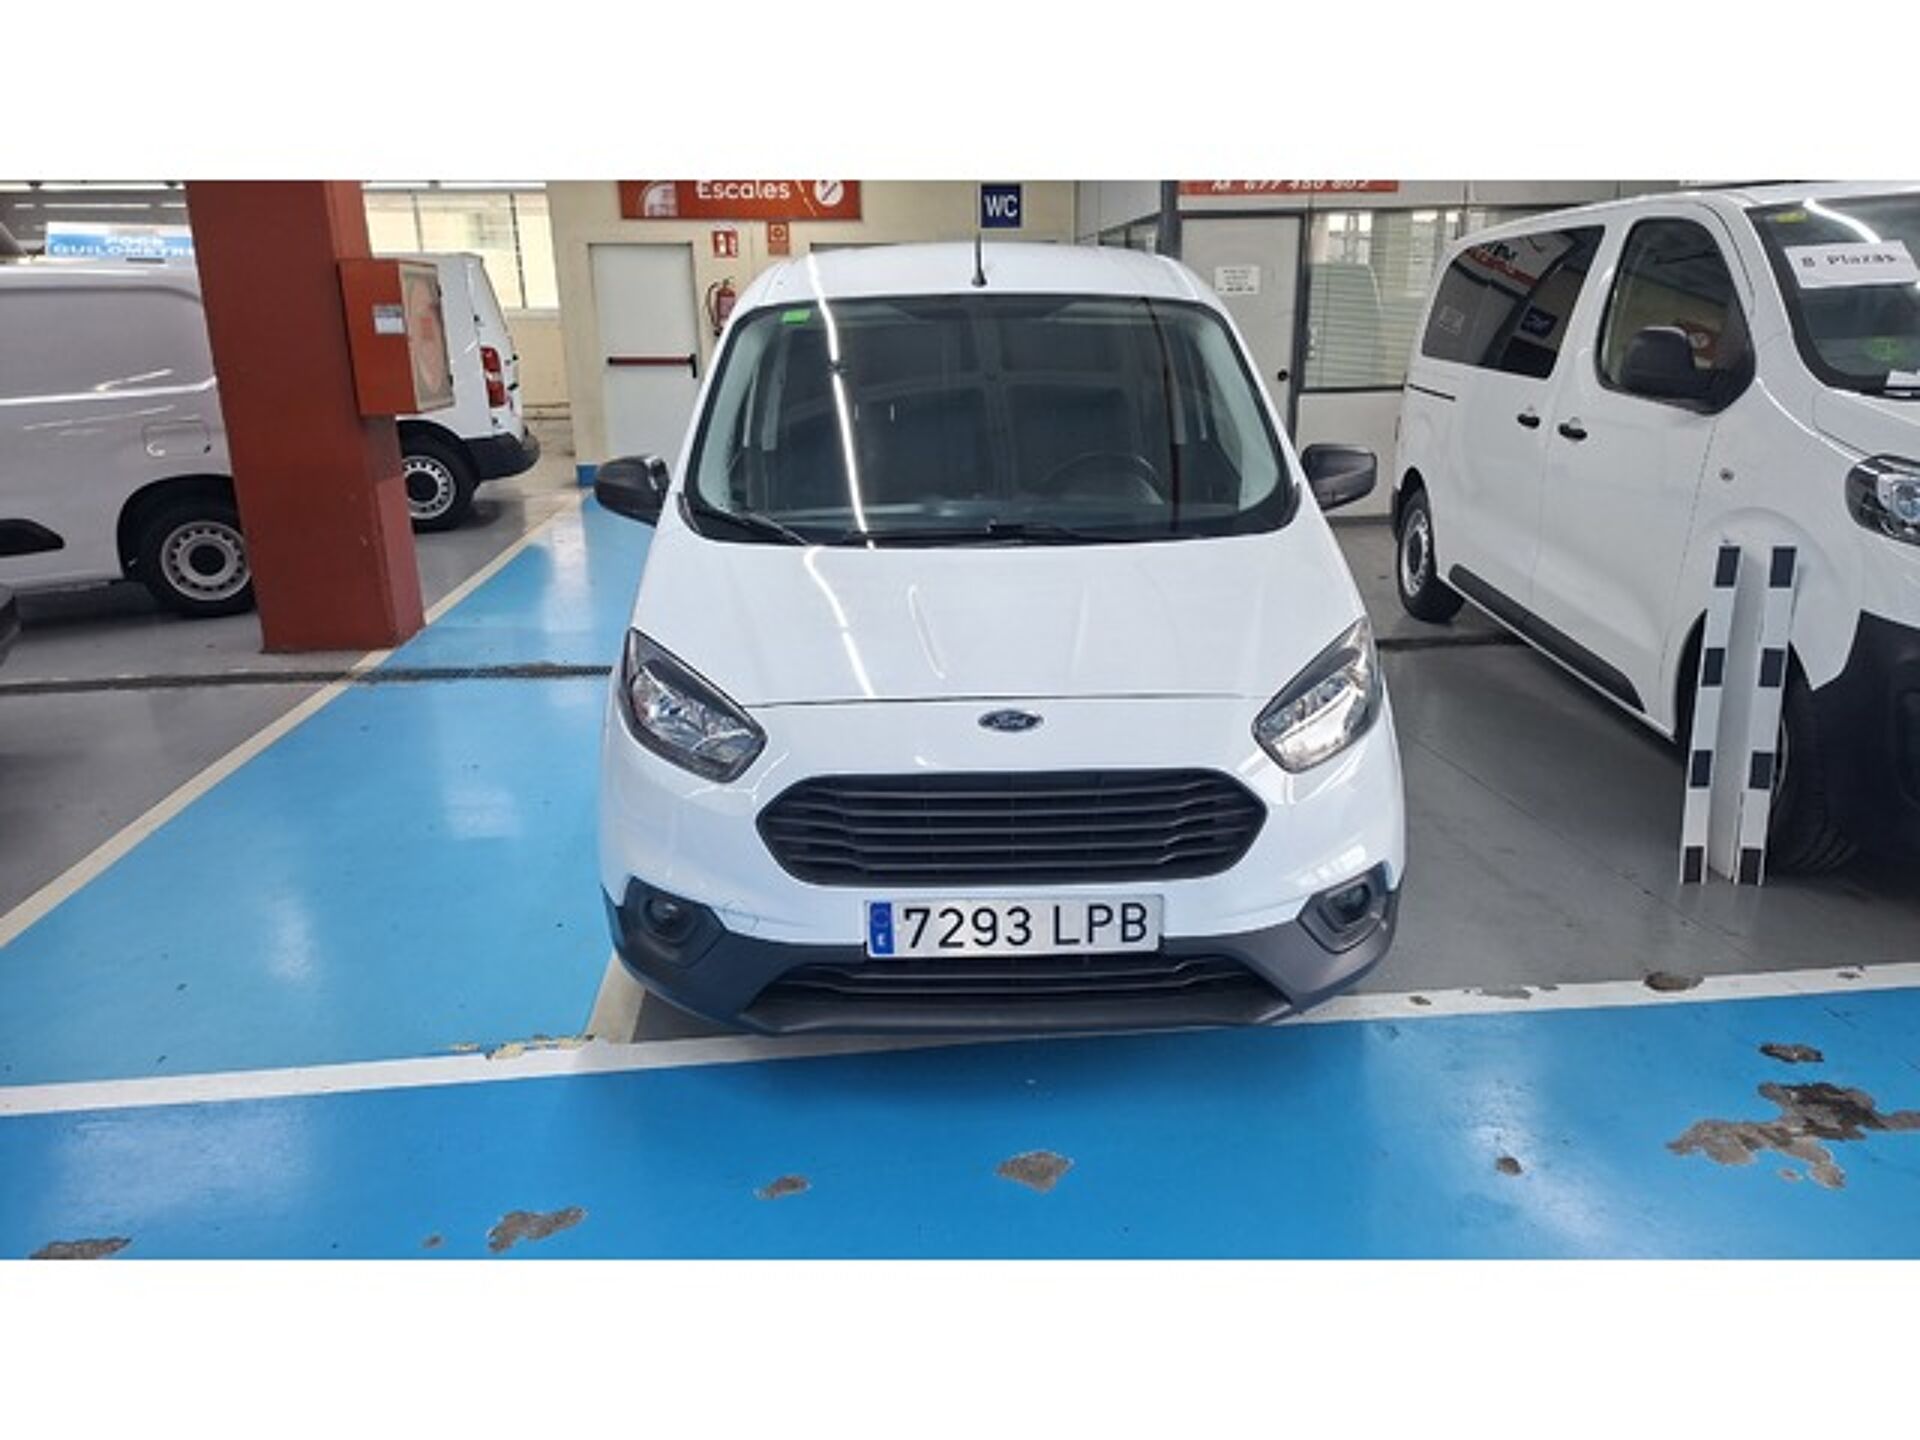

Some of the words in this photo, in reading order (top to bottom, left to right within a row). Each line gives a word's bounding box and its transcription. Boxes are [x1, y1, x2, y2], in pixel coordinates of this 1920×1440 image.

[696, 180, 791, 200] Escales
[983, 193, 1018, 217] WC
[904, 906, 1033, 949] 7293
[1053, 902, 1148, 946] LPB
